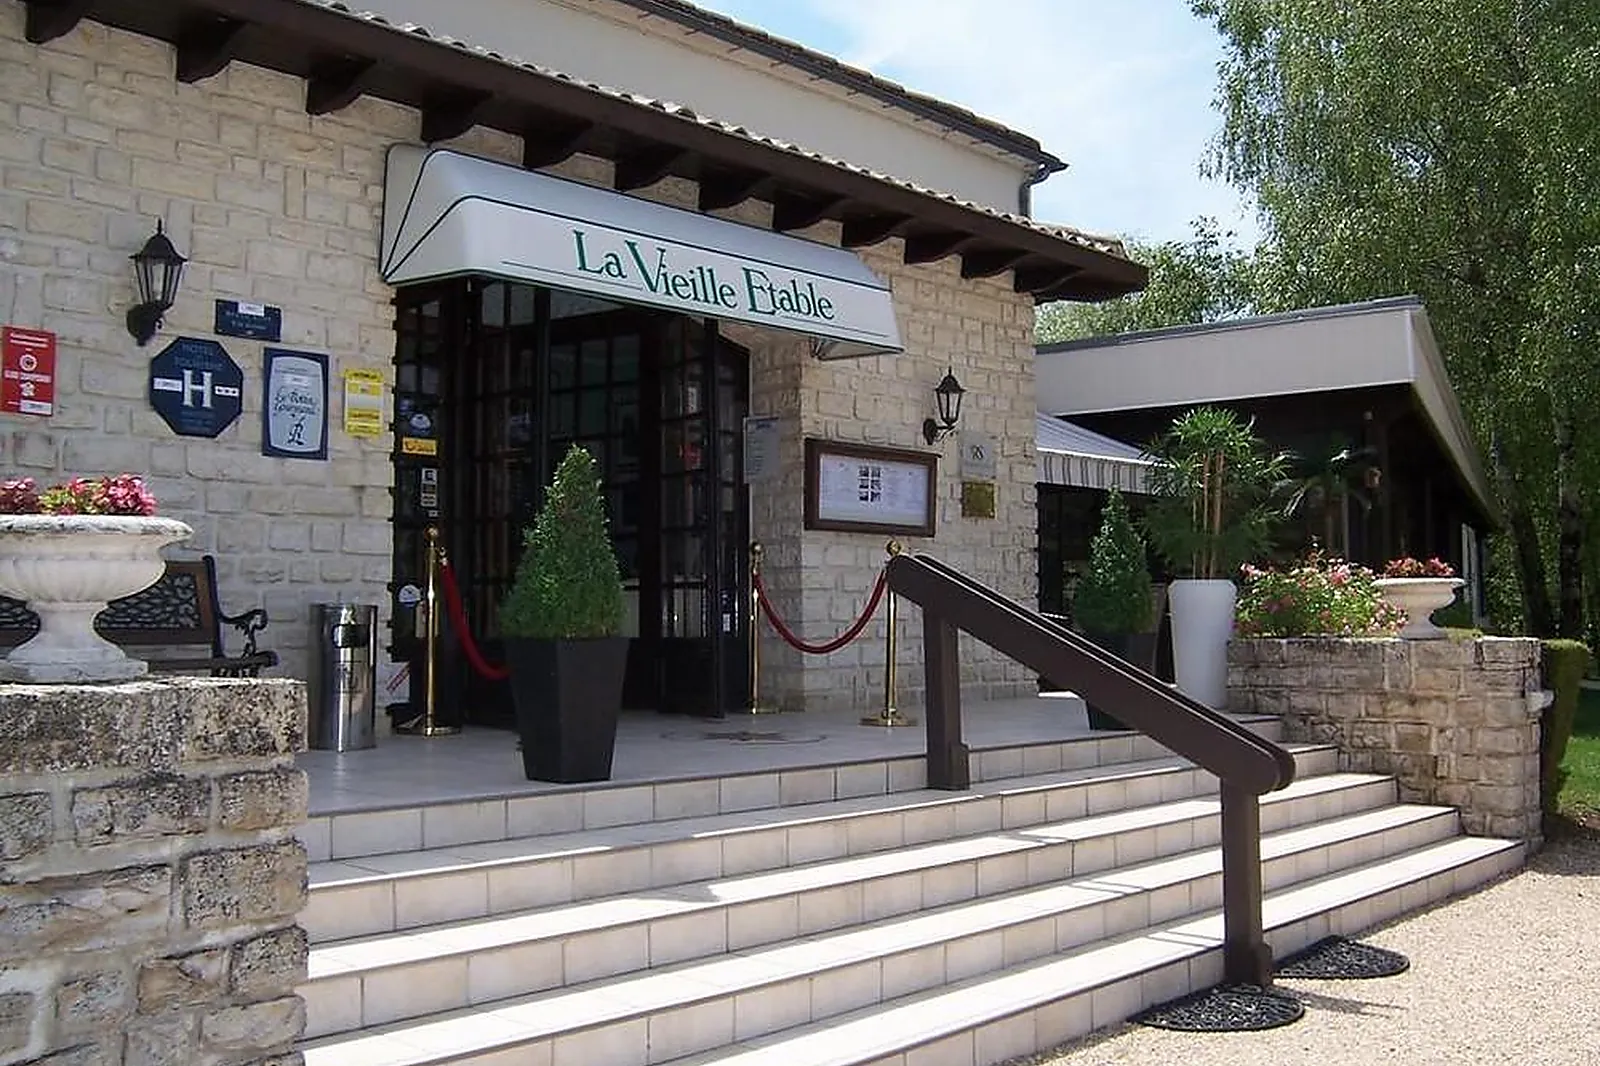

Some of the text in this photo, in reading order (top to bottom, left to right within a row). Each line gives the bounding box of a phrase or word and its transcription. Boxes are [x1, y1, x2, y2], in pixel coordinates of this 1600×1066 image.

[573, 229, 835, 319] La Vieille Etable
[181, 368, 214, 409] H
